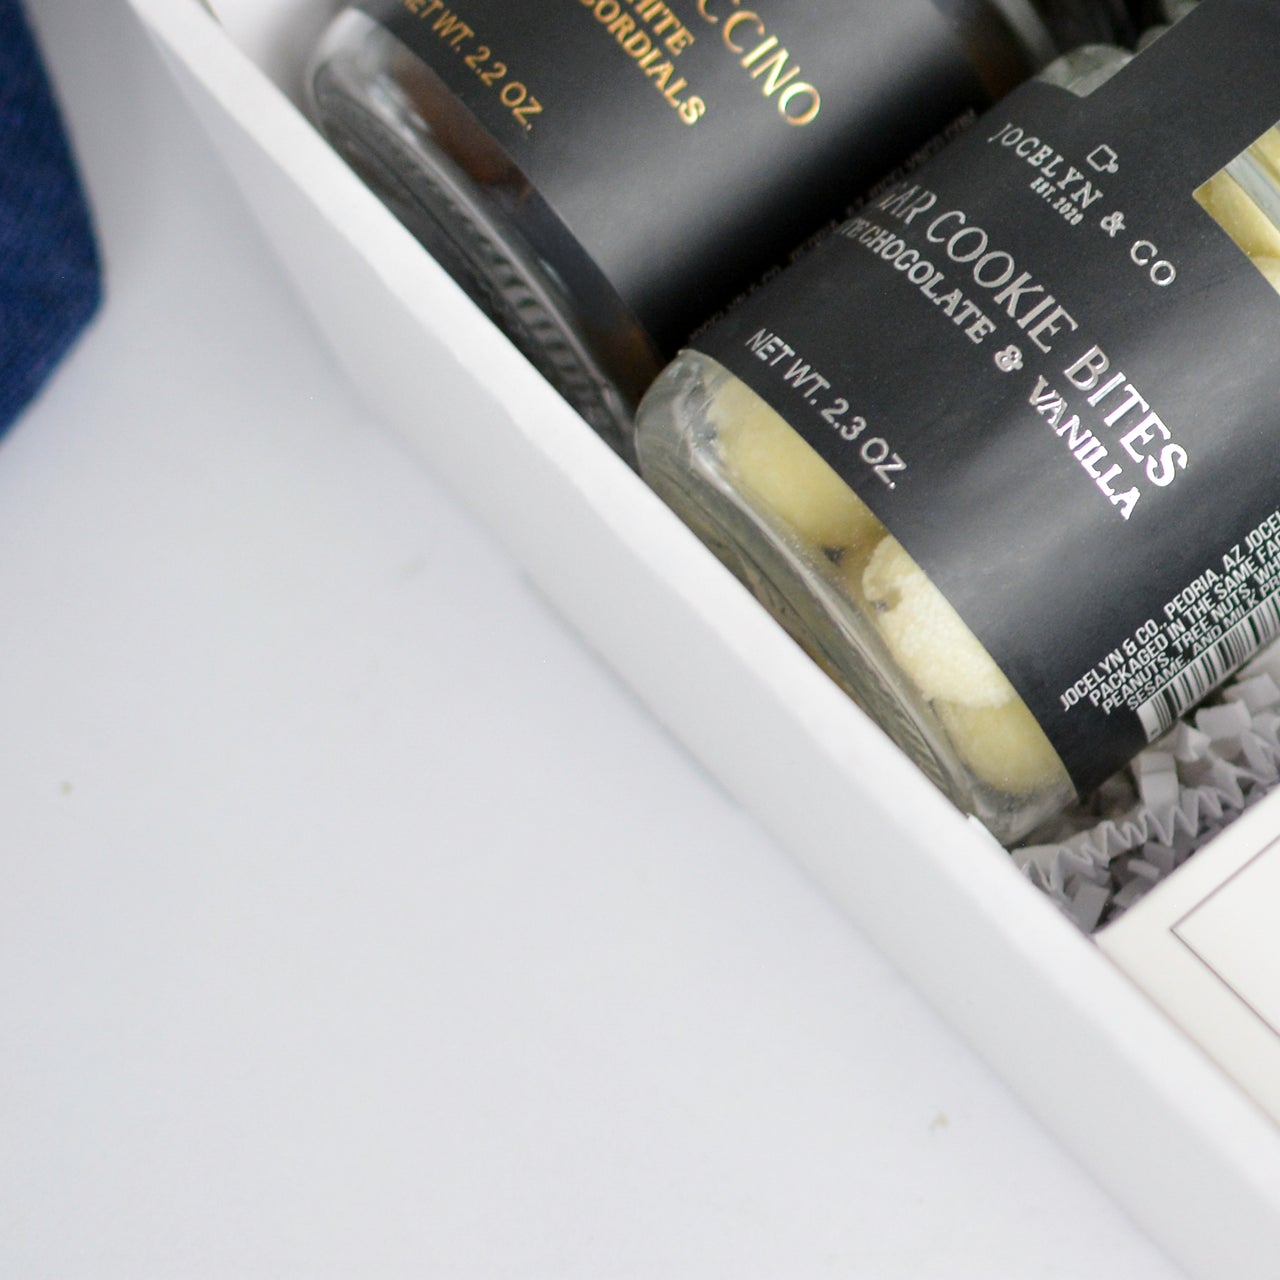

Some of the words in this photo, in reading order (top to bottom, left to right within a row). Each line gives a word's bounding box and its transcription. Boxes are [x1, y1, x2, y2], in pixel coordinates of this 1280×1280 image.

[432, 9, 475, 53] WT.
[464, 45, 506, 86] 2.2
[500, 81, 543, 131] OZ.
[988, 122, 1104, 209] JOCELYN
[1100, 211, 1126, 237] &
[1130, 240, 1177, 286] CO
[1053, 196, 1085, 225] 2020
[745, 328, 796, 367] NET
[784, 358, 831, 405] WT.
[821, 398, 867, 441] 2.3
[861, 437, 907, 490] OZ.
[927, 210, 1079, 353] COOKIE
[1063, 345, 1188, 487] BITES
[995, 345, 1023, 372] &
[1029, 375, 1141, 521] VANILLA
[1060, 649, 1124, 712] JOCELYN
[1122, 638, 1137, 657] &
[1163, 568, 1223, 620] PEORIA,
[1222, 544, 1245, 571] AZ
[1089, 634, 1169, 707] PACKAGED
[1166, 618, 1186, 640] IN
[1183, 592, 1216, 624] THE
[1214, 556, 1259, 600] SAME
[1172, 615, 1211, 654] TREE
[1192, 624, 1223, 657] AND
[1223, 593, 1259, 632] MILK
